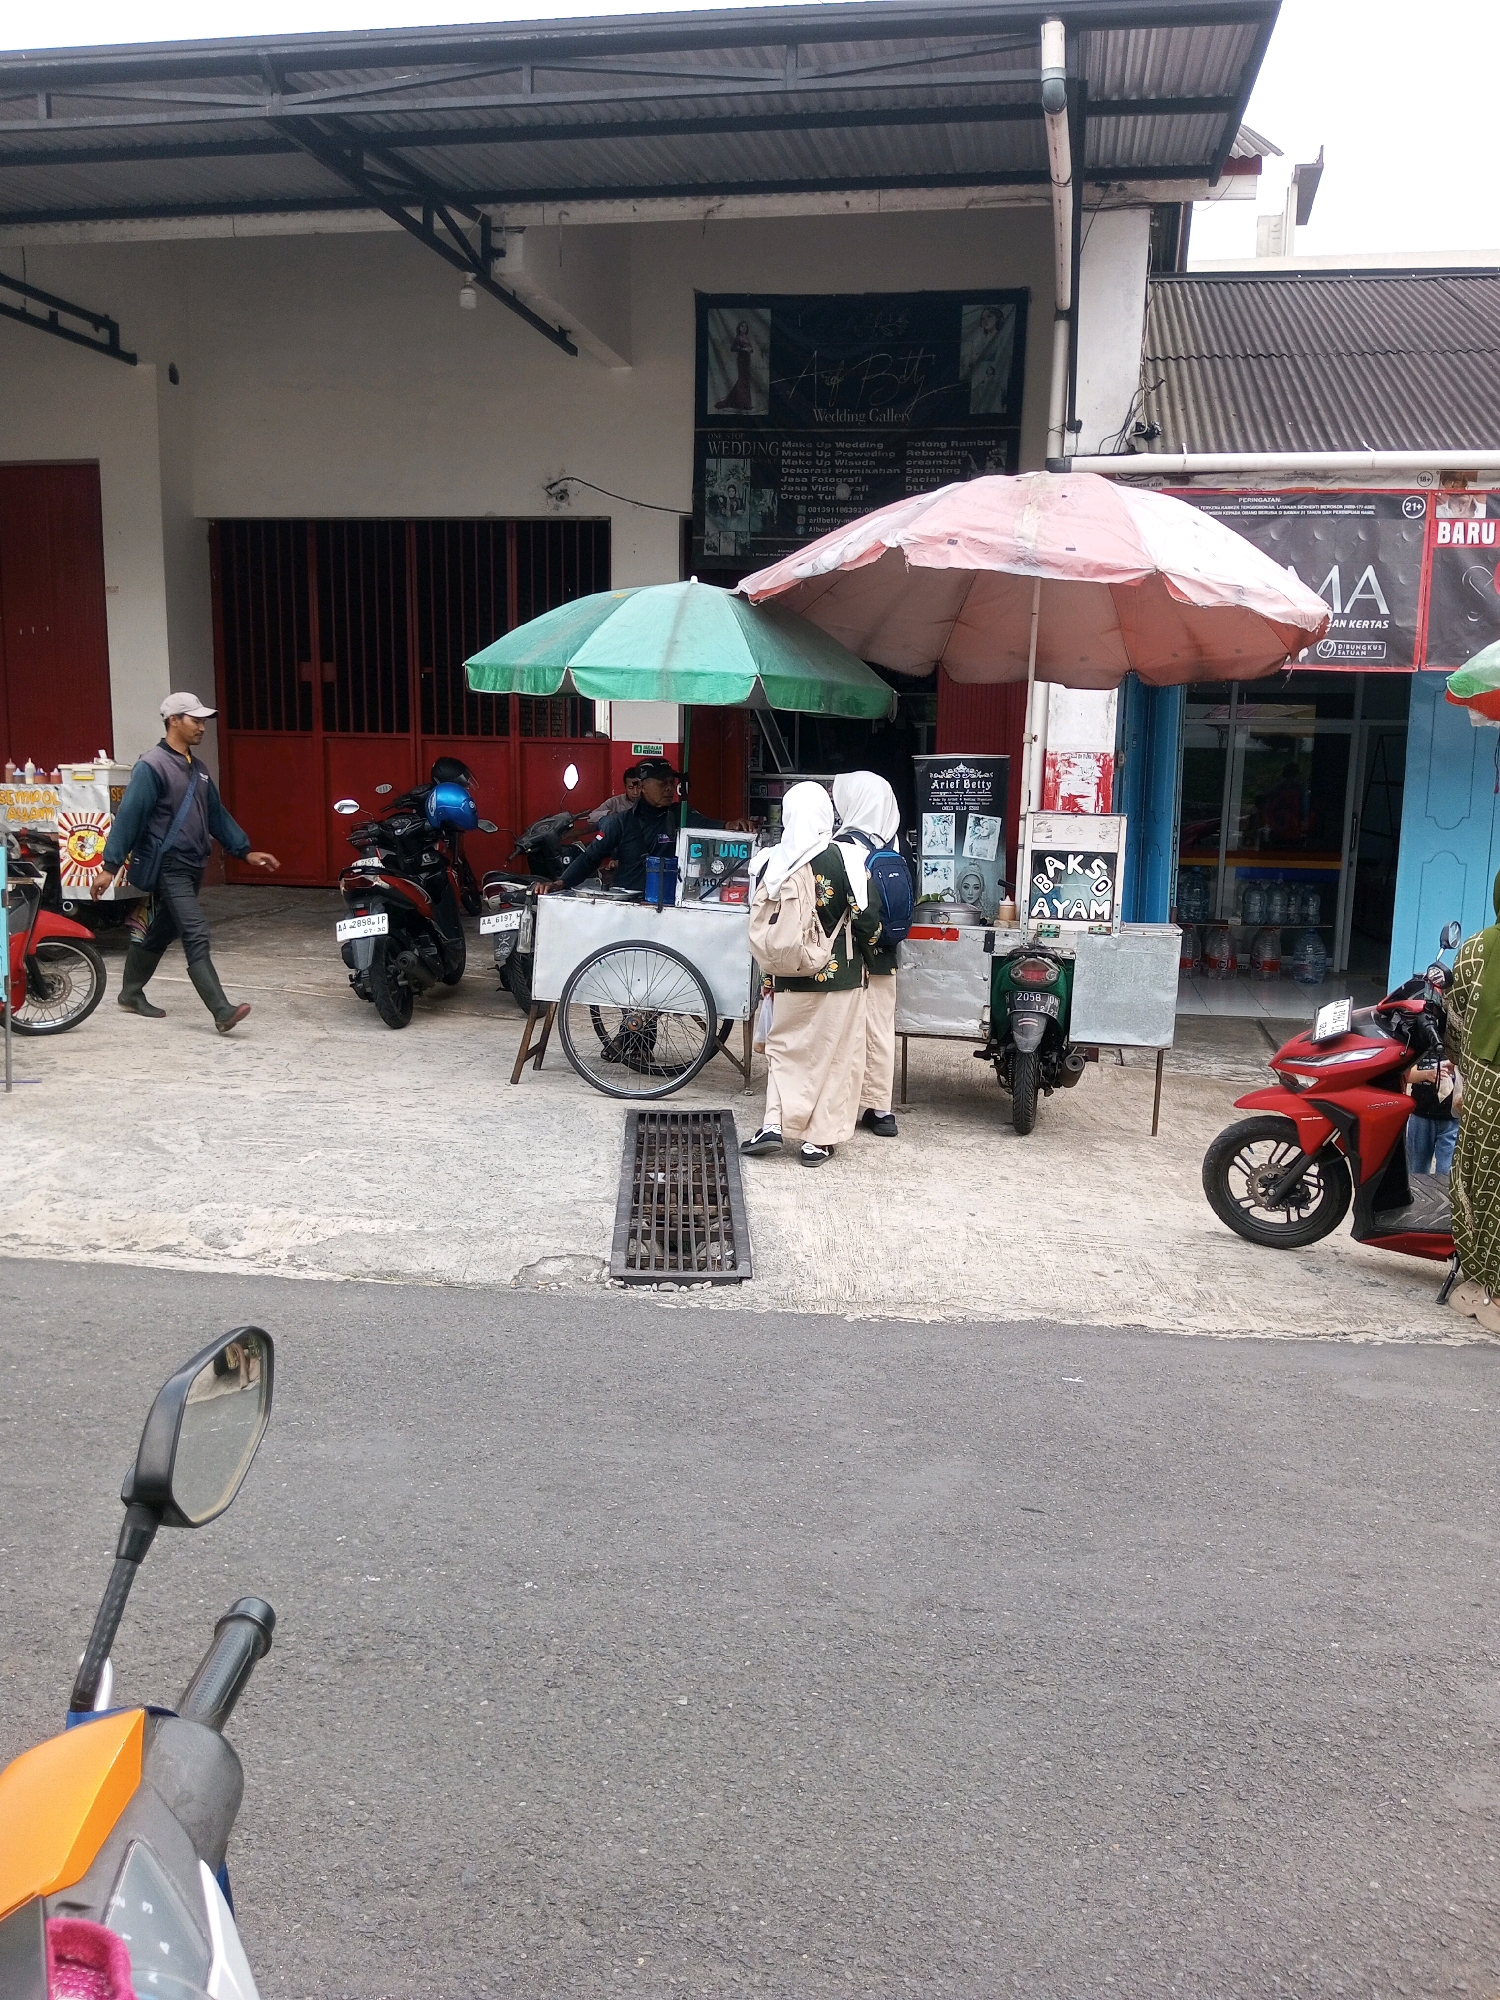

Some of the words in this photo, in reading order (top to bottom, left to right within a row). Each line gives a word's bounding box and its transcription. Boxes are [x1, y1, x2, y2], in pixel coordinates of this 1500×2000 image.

[813, 408, 866, 426] Wedding
[869, 408, 912, 425] Gallery
[708, 441, 779, 457] WEDDING
[782, 441, 813, 449] Make
[816, 442, 831, 450] Up
[835, 441, 884, 450] Wedding
[816, 450, 831, 458] Up
[906, 449, 968, 458] Rebonding
[815, 459, 831, 467] Up
[906, 467, 961, 475] Smothing
[811, 476, 863, 484] Fotografi
[811, 484, 869, 492] Viderafi
[1405, 502, 1422, 511] 21+
[1437, 521, 1495, 545] BARU
[1331, 619, 1346, 629] AN
[1348, 619, 1390, 629] KERTAS
[930, 779, 960, 789] Arief
[963, 779, 992, 790] Betty
[1032, 854, 1112, 896] BAKSO
[1031, 899, 1112, 920] AYAM
[338, 923, 346, 932] AA
[352, 917, 372, 928] 2898
[481, 918, 492, 926] AA
[495, 913, 512, 923] 6197
[1016, 992, 1042, 1002] 2058
